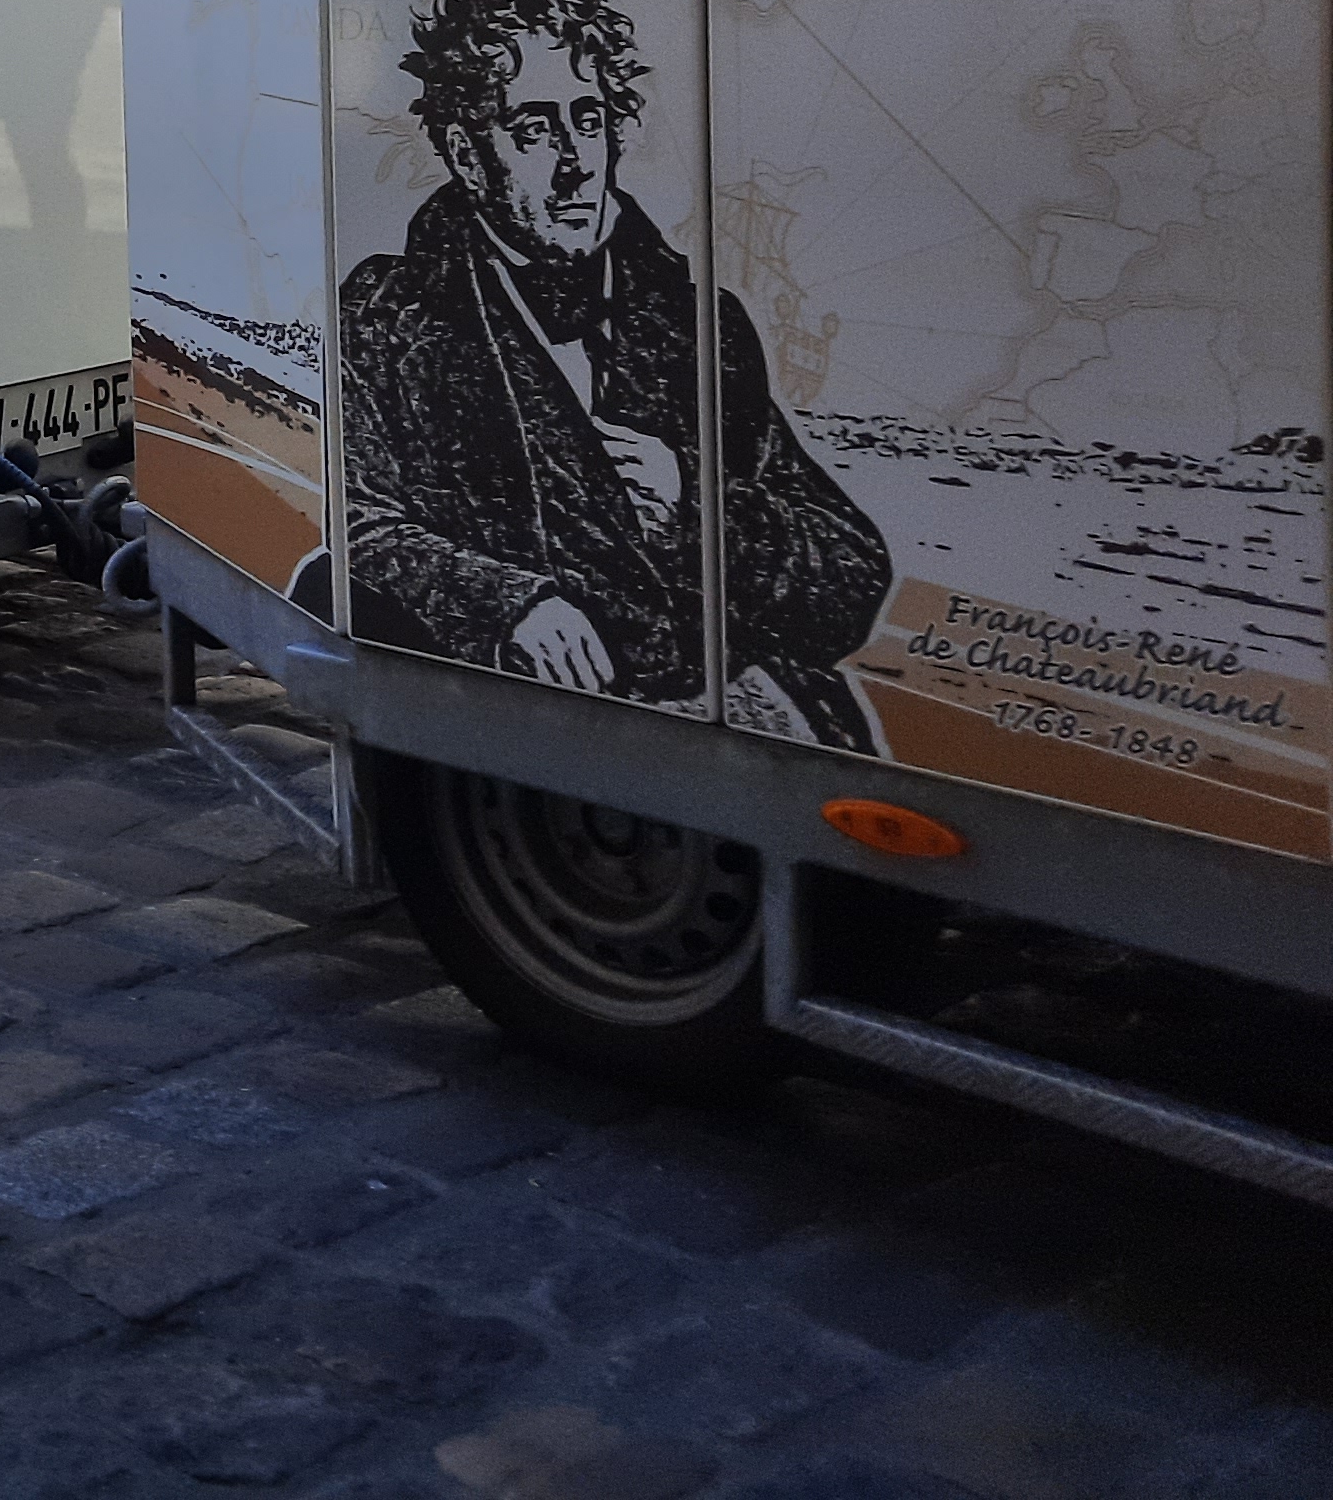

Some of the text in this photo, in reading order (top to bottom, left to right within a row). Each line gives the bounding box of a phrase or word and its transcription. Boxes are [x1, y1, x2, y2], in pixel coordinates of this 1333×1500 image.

[907, 623, 1287, 728] de Chateaubriand
[945, 595, 1245, 675] François-René
